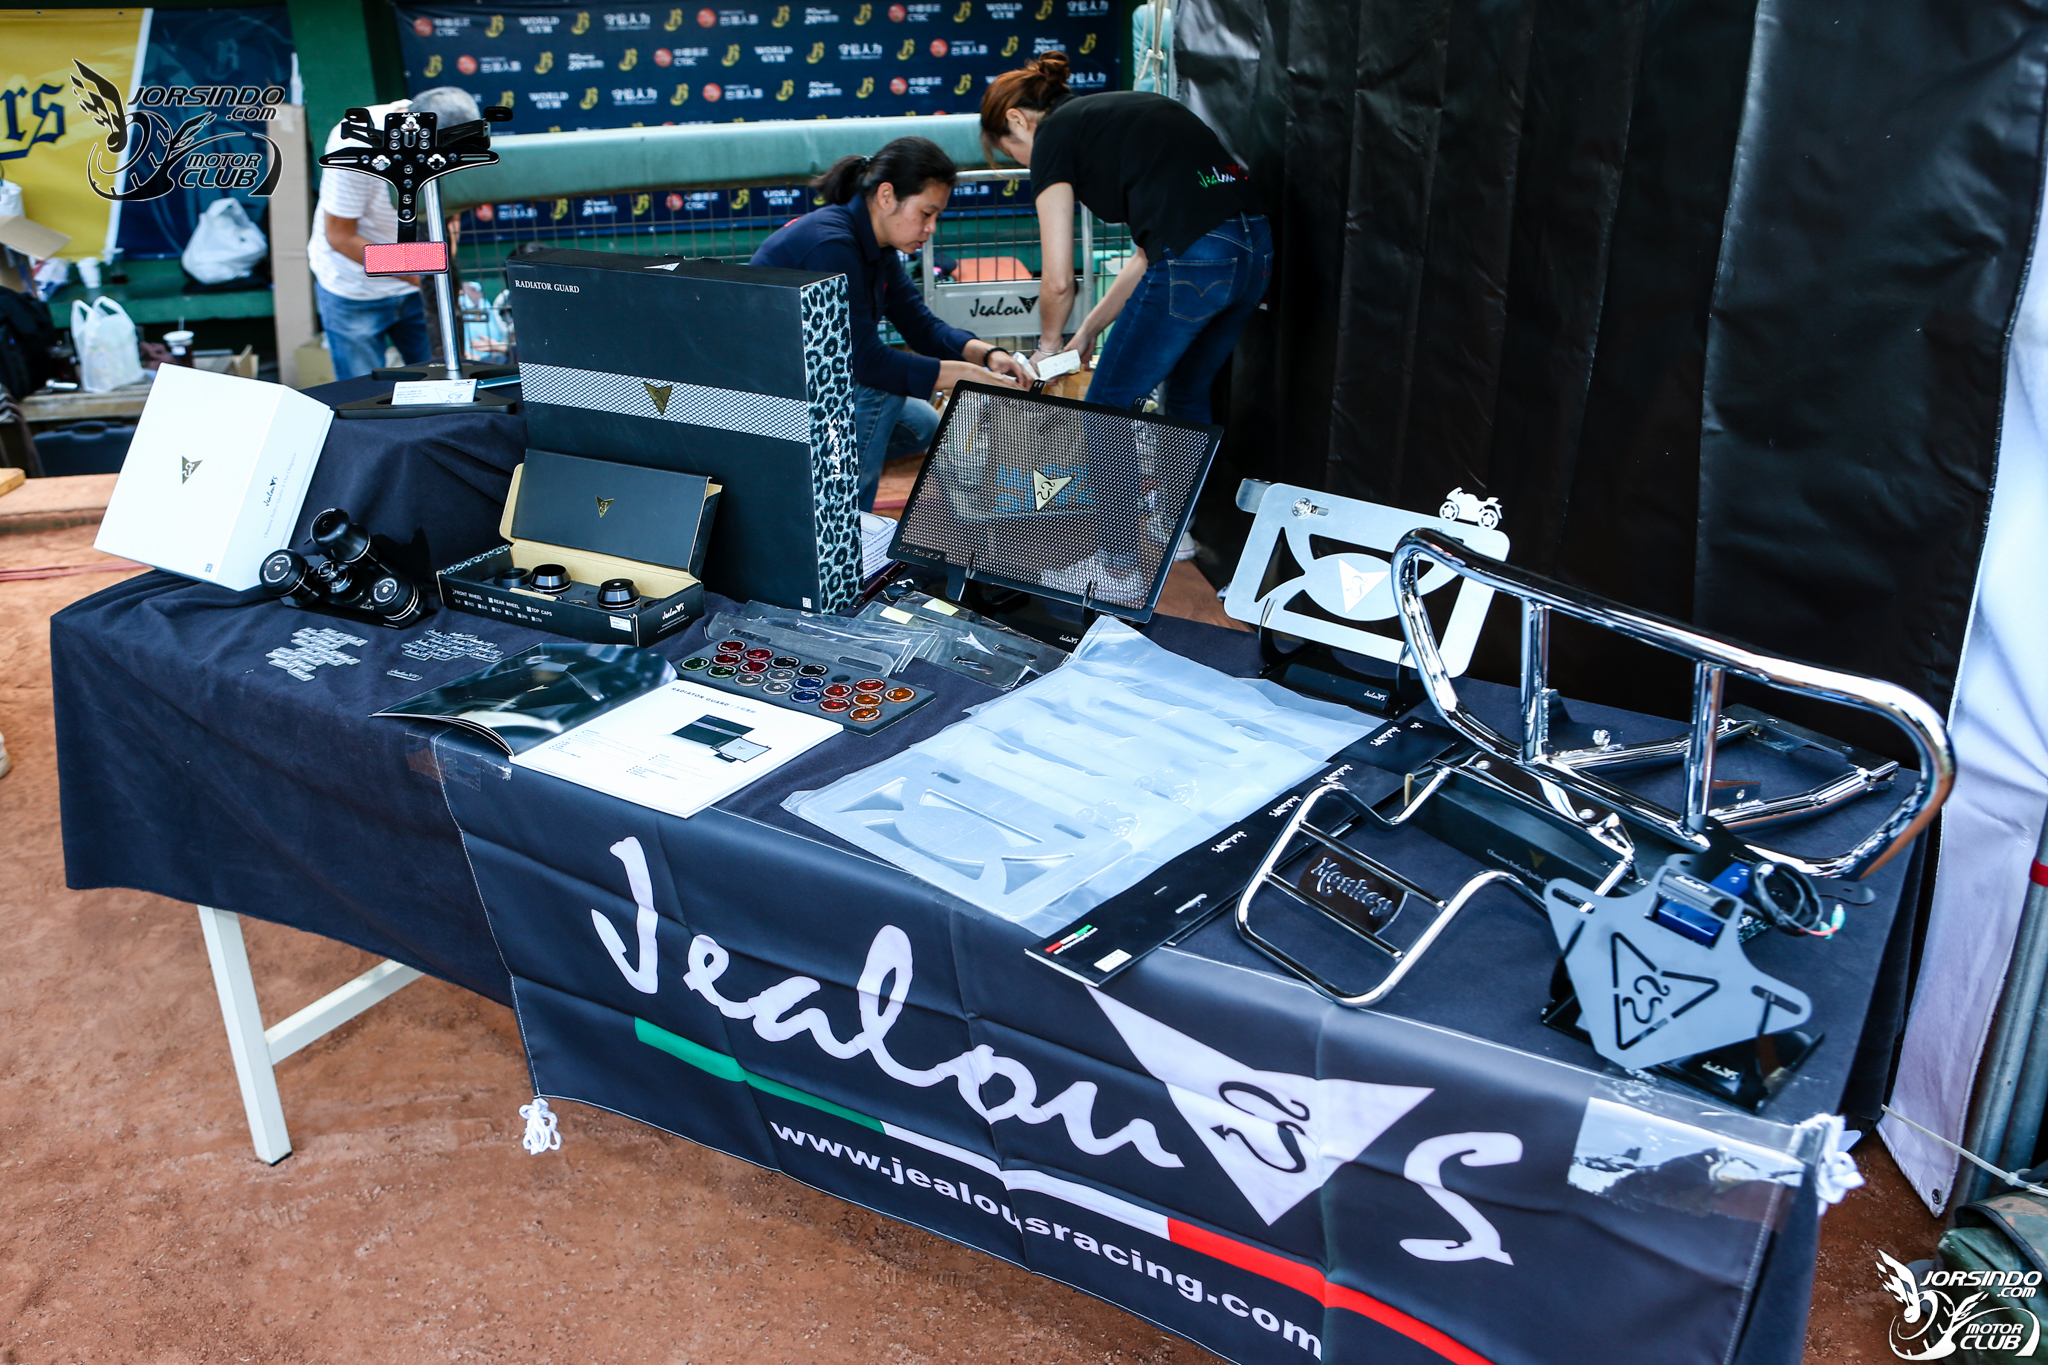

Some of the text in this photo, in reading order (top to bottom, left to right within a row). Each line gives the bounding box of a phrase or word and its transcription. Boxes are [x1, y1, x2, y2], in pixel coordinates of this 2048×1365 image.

[514, 280, 580, 294] RADIATOR GUARD
[970, 295, 1039, 318] Jealou
[670, 686, 704, 700] RADIATOR
[705, 696, 730, 708] GUARD
[1310, 856, 1394, 917] Monkey
[770, 1120, 1322, 1362] www.jealousracing.com
